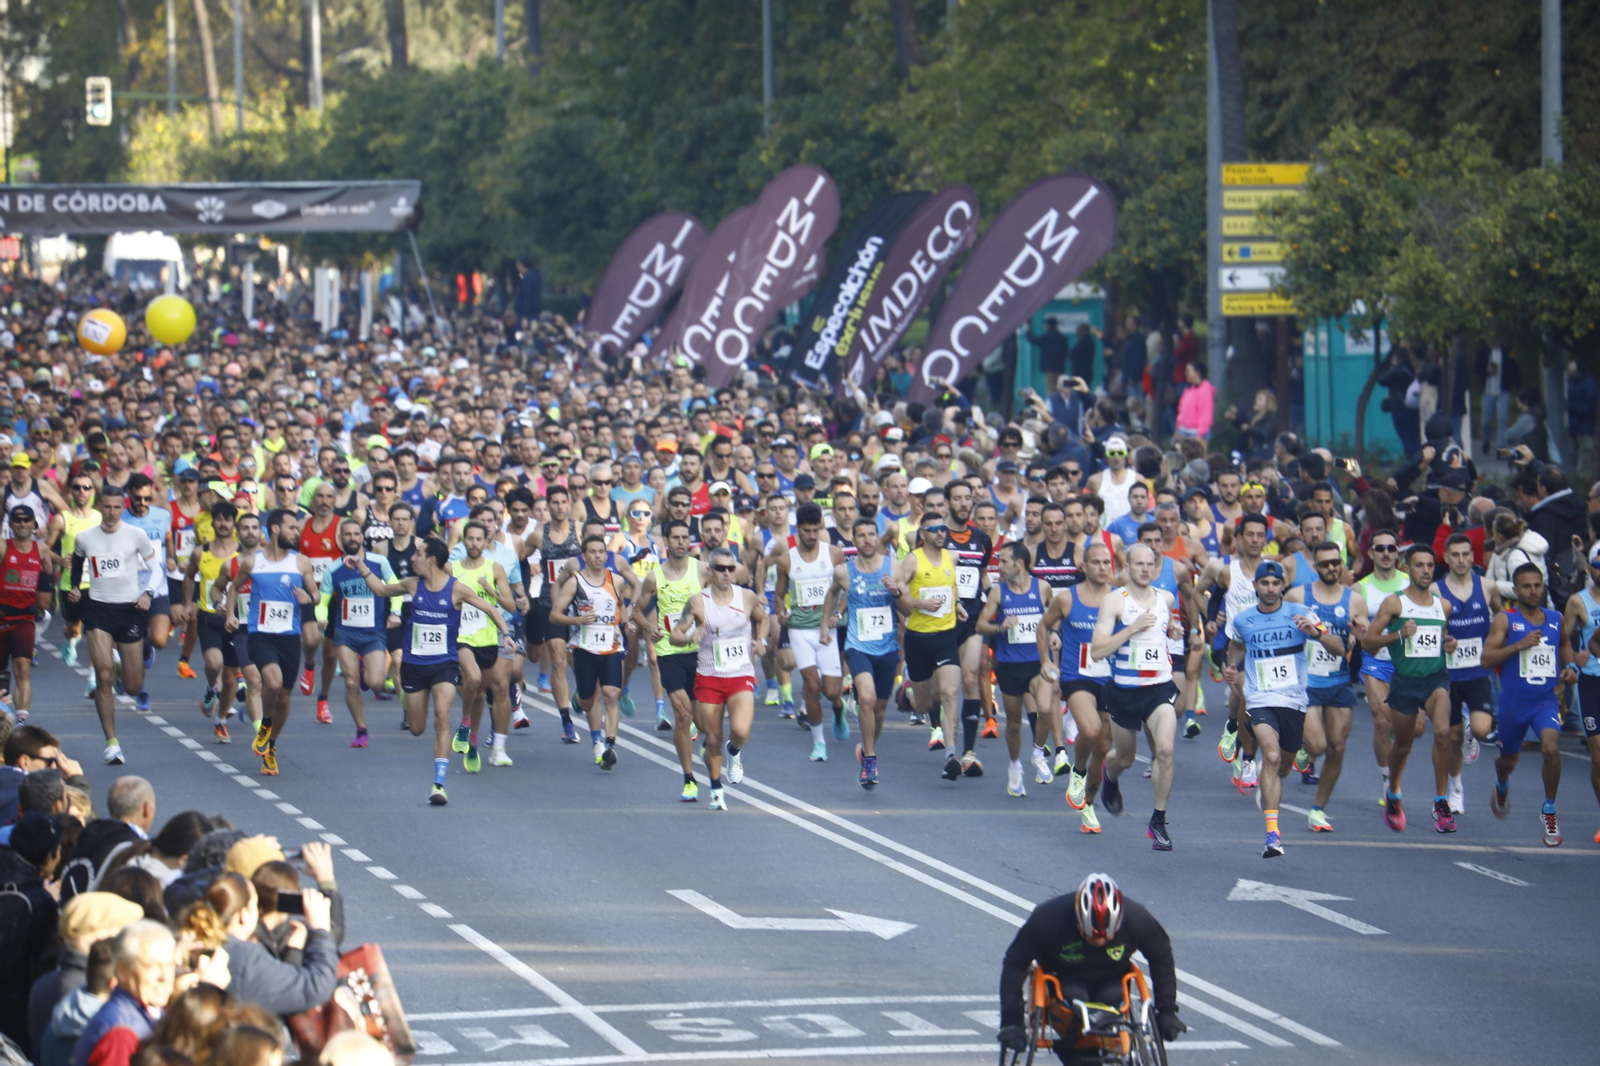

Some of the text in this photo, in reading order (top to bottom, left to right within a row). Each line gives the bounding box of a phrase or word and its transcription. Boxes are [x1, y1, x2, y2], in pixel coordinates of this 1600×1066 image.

[17, 194, 46, 213] DE
[52, 190, 167, 213] CÓRDOBA
[715, 174, 826, 366] IMDECO
[860, 200, 972, 353] IMDECO
[922, 184, 1100, 386] IMDECO
[804, 235, 885, 371] Especolchón
[100, 559, 119, 570] 260
[960, 574, 972, 584] 87
[807, 586, 825, 598] 386
[269, 608, 289, 620] 342
[351, 604, 370, 614] 413
[462, 610, 480, 622] 434
[871, 615, 885, 626] 72
[422, 632, 442, 642] 128
[594, 633, 606, 642] 14
[1250, 630, 1293, 644] ALCALA
[1417, 634, 1437, 646] 454
[725, 645, 744, 657] 133
[1145, 649, 1159, 660] 64
[1457, 646, 1478, 658] 358
[1531, 654, 1551, 666] 464
[1272, 666, 1288, 678] 15
